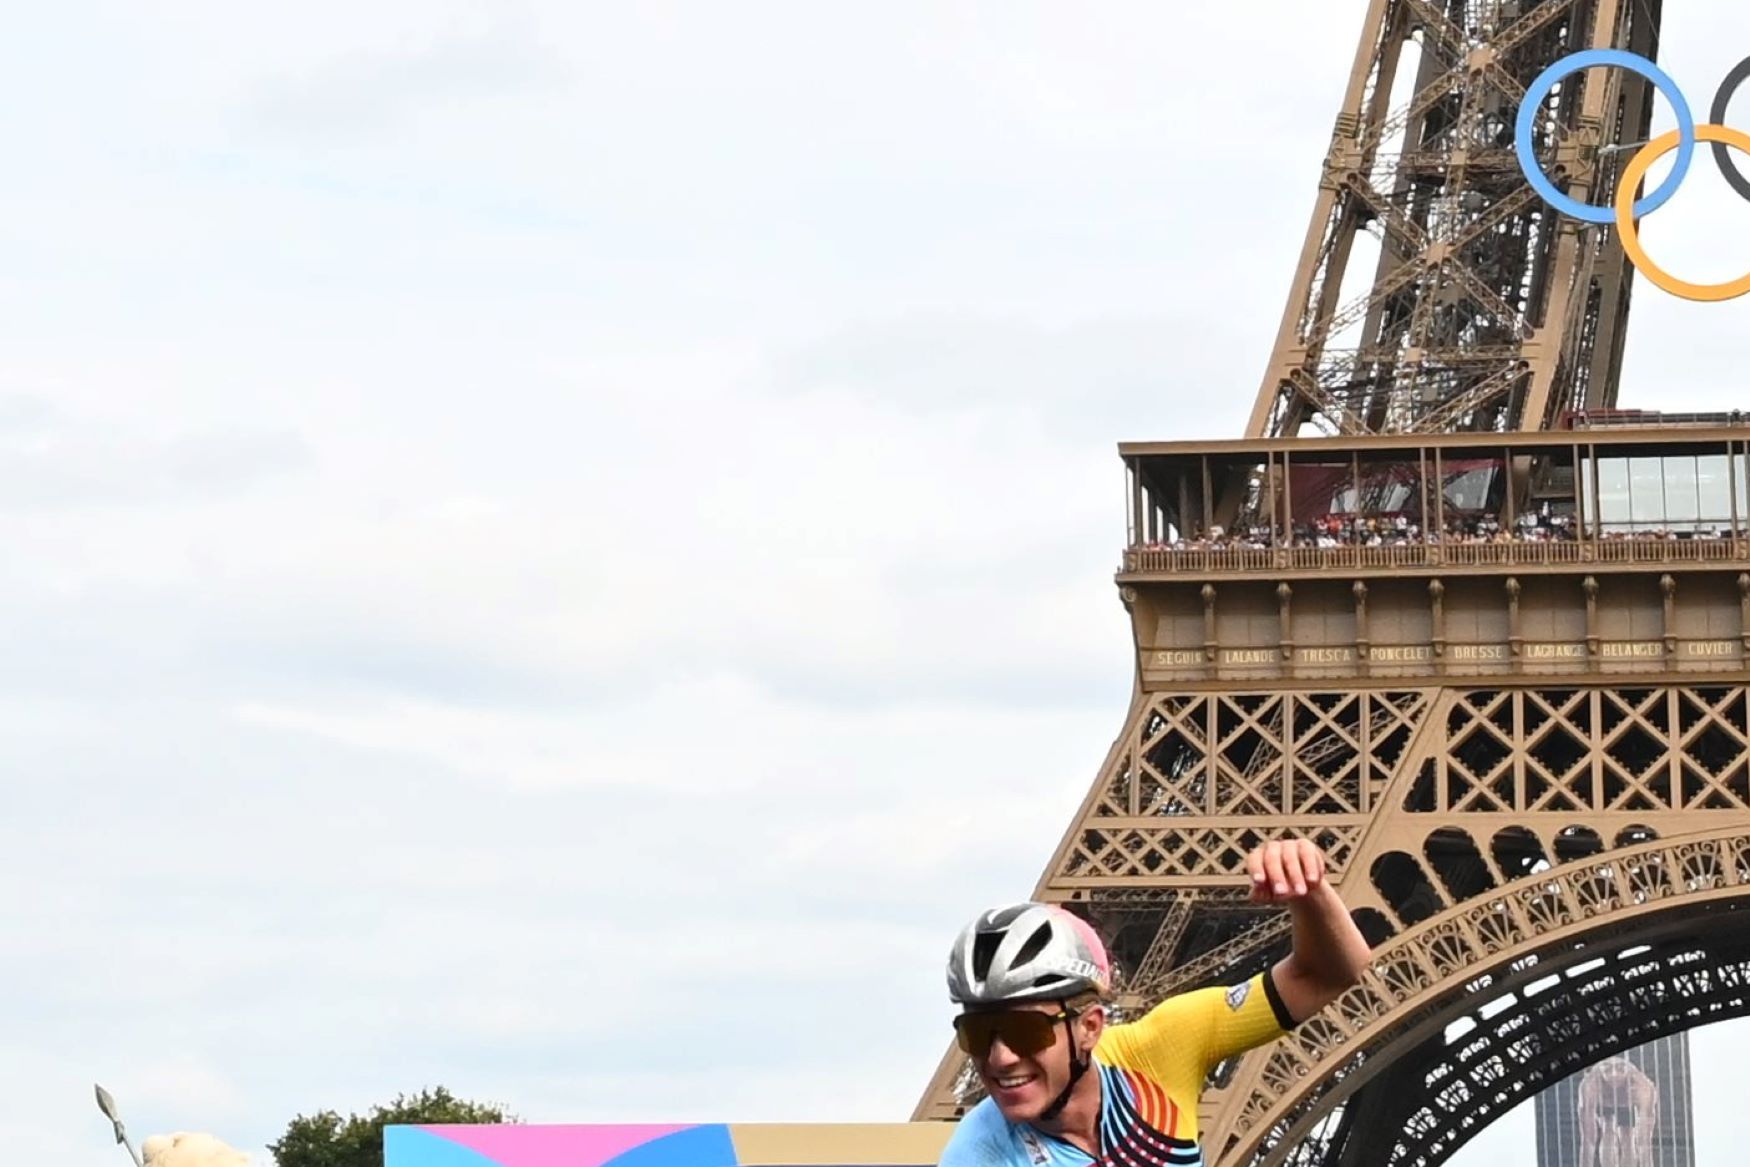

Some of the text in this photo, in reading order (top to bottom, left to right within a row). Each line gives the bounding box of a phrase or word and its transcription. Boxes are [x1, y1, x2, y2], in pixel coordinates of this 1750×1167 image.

[1370, 646, 1430, 661] PONCELET
[1454, 645, 1503, 659] BRESSE
[1527, 643, 1585, 657] LAGRANGE
[1602, 642, 1662, 657] BELANGER
[1688, 641, 1732, 655] CUVIER
[1225, 650, 1274, 663] LALANDE
[1303, 649, 1351, 662] TRESCA
